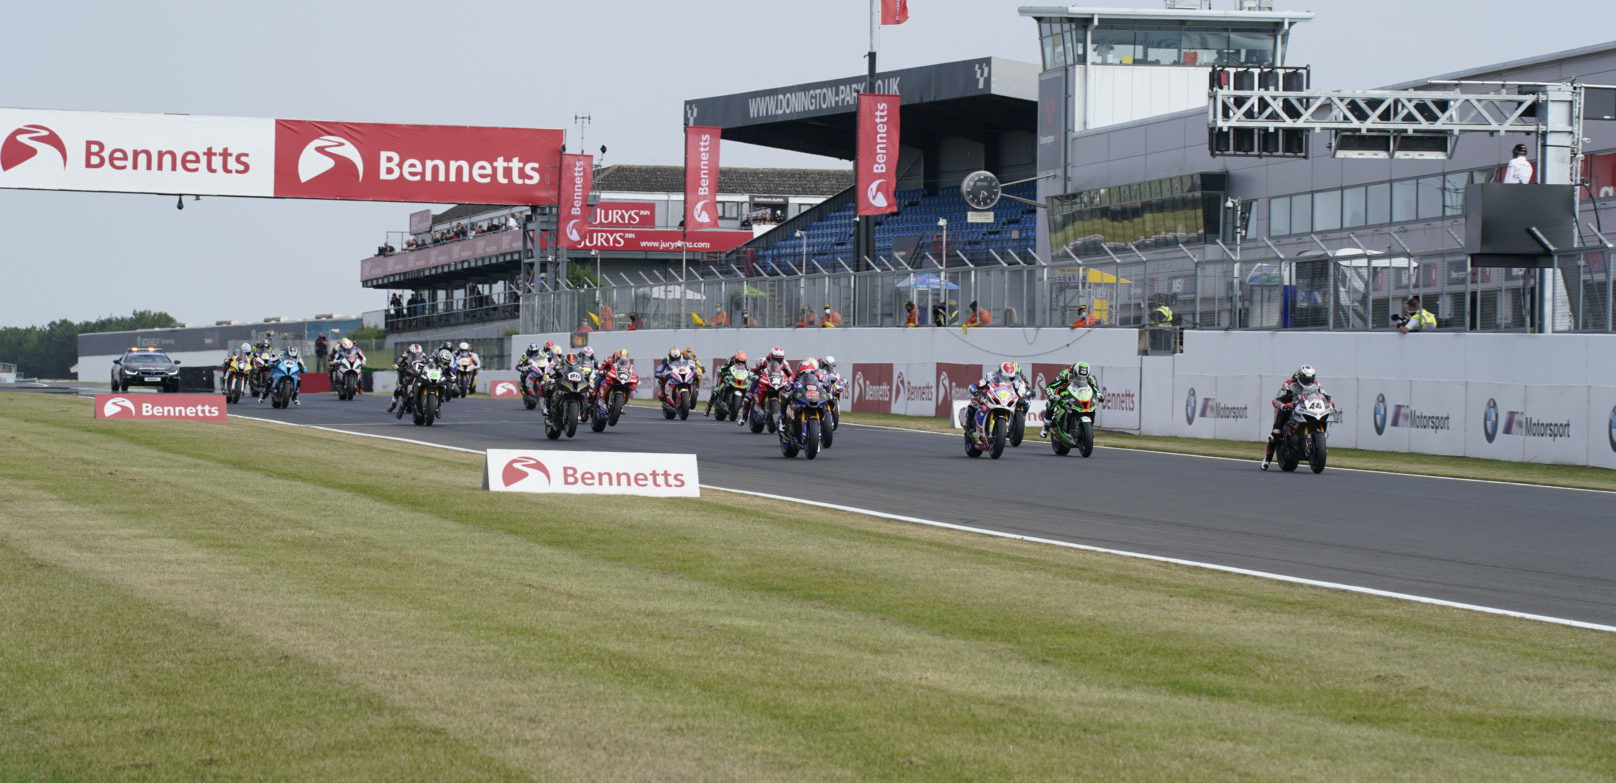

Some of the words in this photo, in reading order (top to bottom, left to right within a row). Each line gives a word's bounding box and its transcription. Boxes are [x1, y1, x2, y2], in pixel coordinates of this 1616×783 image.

[873, 102, 888, 173] Bennetts
[84, 140, 250, 175] Bennetts
[379, 151, 540, 186] Bennetts
[698, 134, 710, 196] Bennetts
[571, 159, 584, 215] Bennetts
[592, 207, 640, 225] JURYS
[866, 380, 889, 401] Bennetts
[907, 380, 933, 401] Bennetts
[1101, 386, 1135, 412] Bennetts
[142, 403, 219, 417] Bennetts
[1215, 402, 1248, 421] Motorsport
[1410, 410, 1450, 433] Motorsport
[1525, 417, 1570, 442] Motorsport
[562, 466, 686, 488] Bennetts
